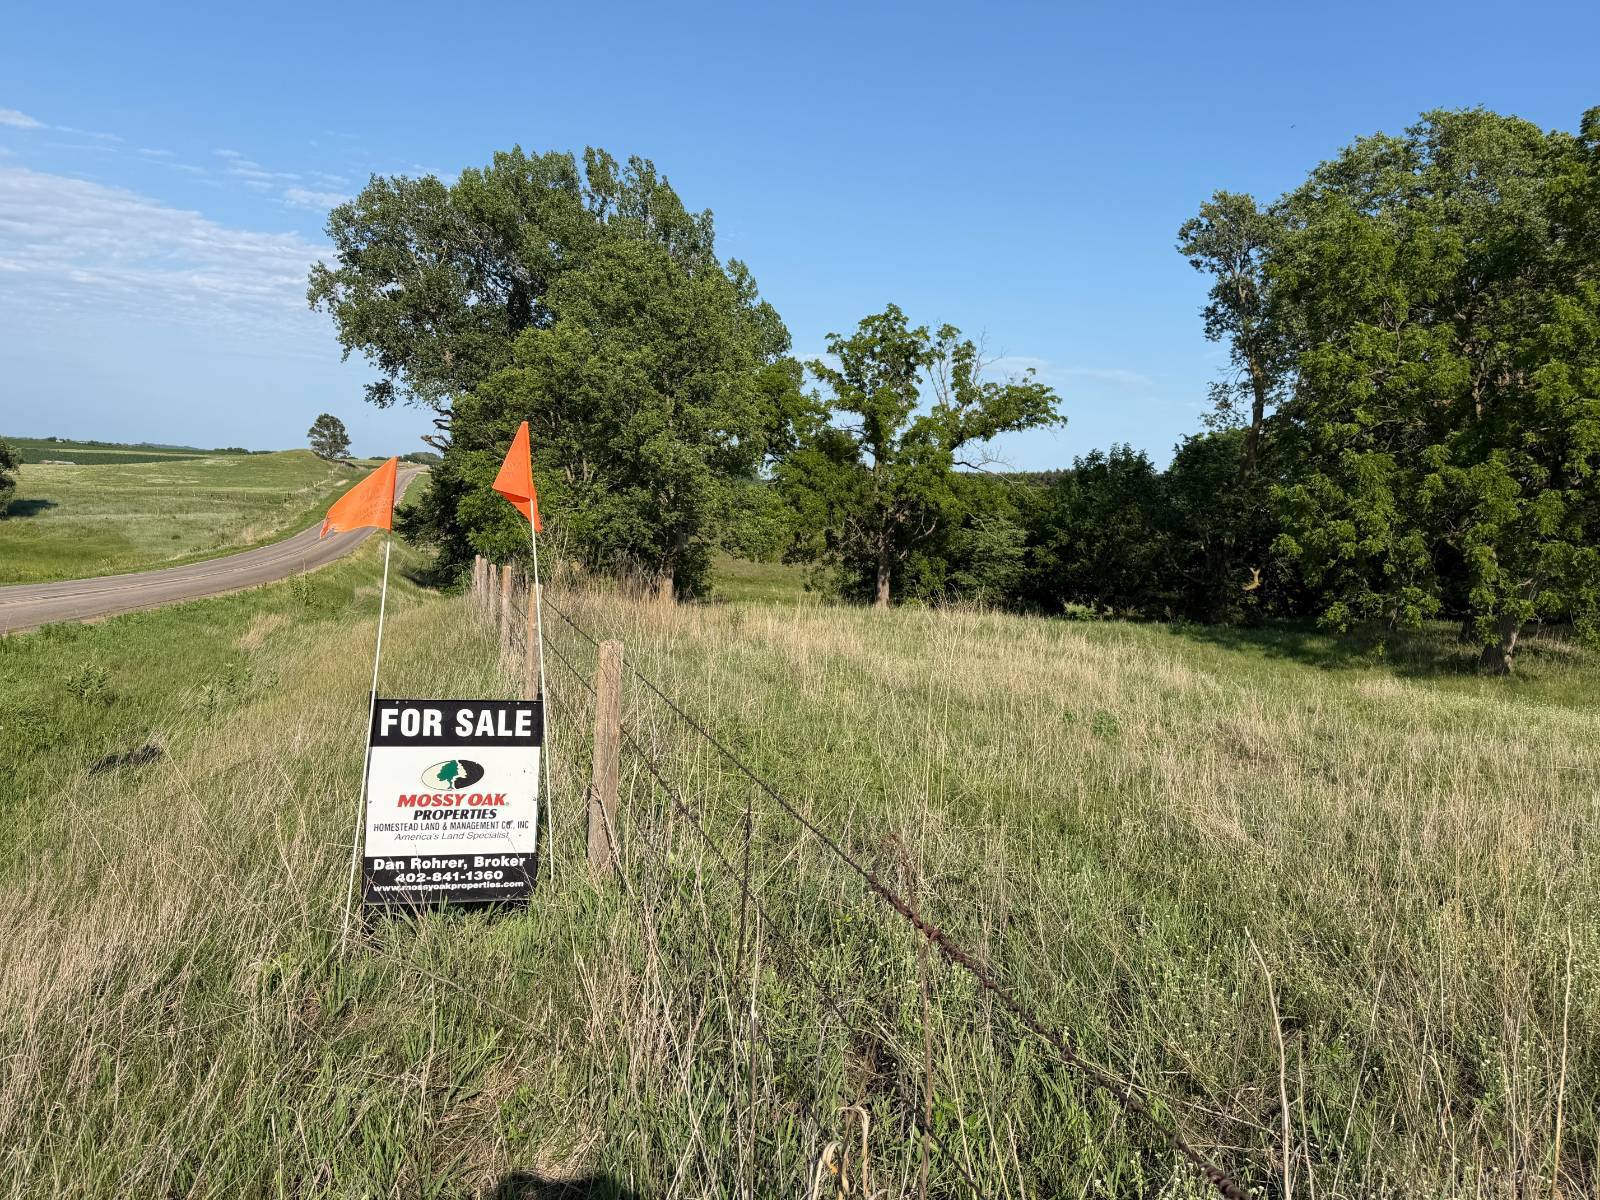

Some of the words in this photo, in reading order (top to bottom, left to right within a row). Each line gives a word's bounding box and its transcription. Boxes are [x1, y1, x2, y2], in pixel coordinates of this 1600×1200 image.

[380, 708, 443, 737] FOR
[455, 708, 532, 738] SALE
[397, 793, 467, 807] MOSSY
[467, 793, 506, 807] OAK
[413, 808, 497, 820] PROPERTIES
[373, 822, 418, 832] HOMESTEAD
[420, 822, 440, 831] LAND
[442, 822, 448, 830] &
[449, 821, 499, 830] MANAGEMENT
[517, 820, 529, 829] INC
[394, 833, 439, 842] America's
[441, 832, 464, 840] Land
[466, 831, 510, 841] Specialist
[373, 858, 405, 871] Dan
[410, 857, 468, 870] Rohrer,
[473, 856, 526, 868] Broker
[394, 870, 504, 883] 402-841-1360
[373, 880, 524, 892] www.mossyoakproperties.com
